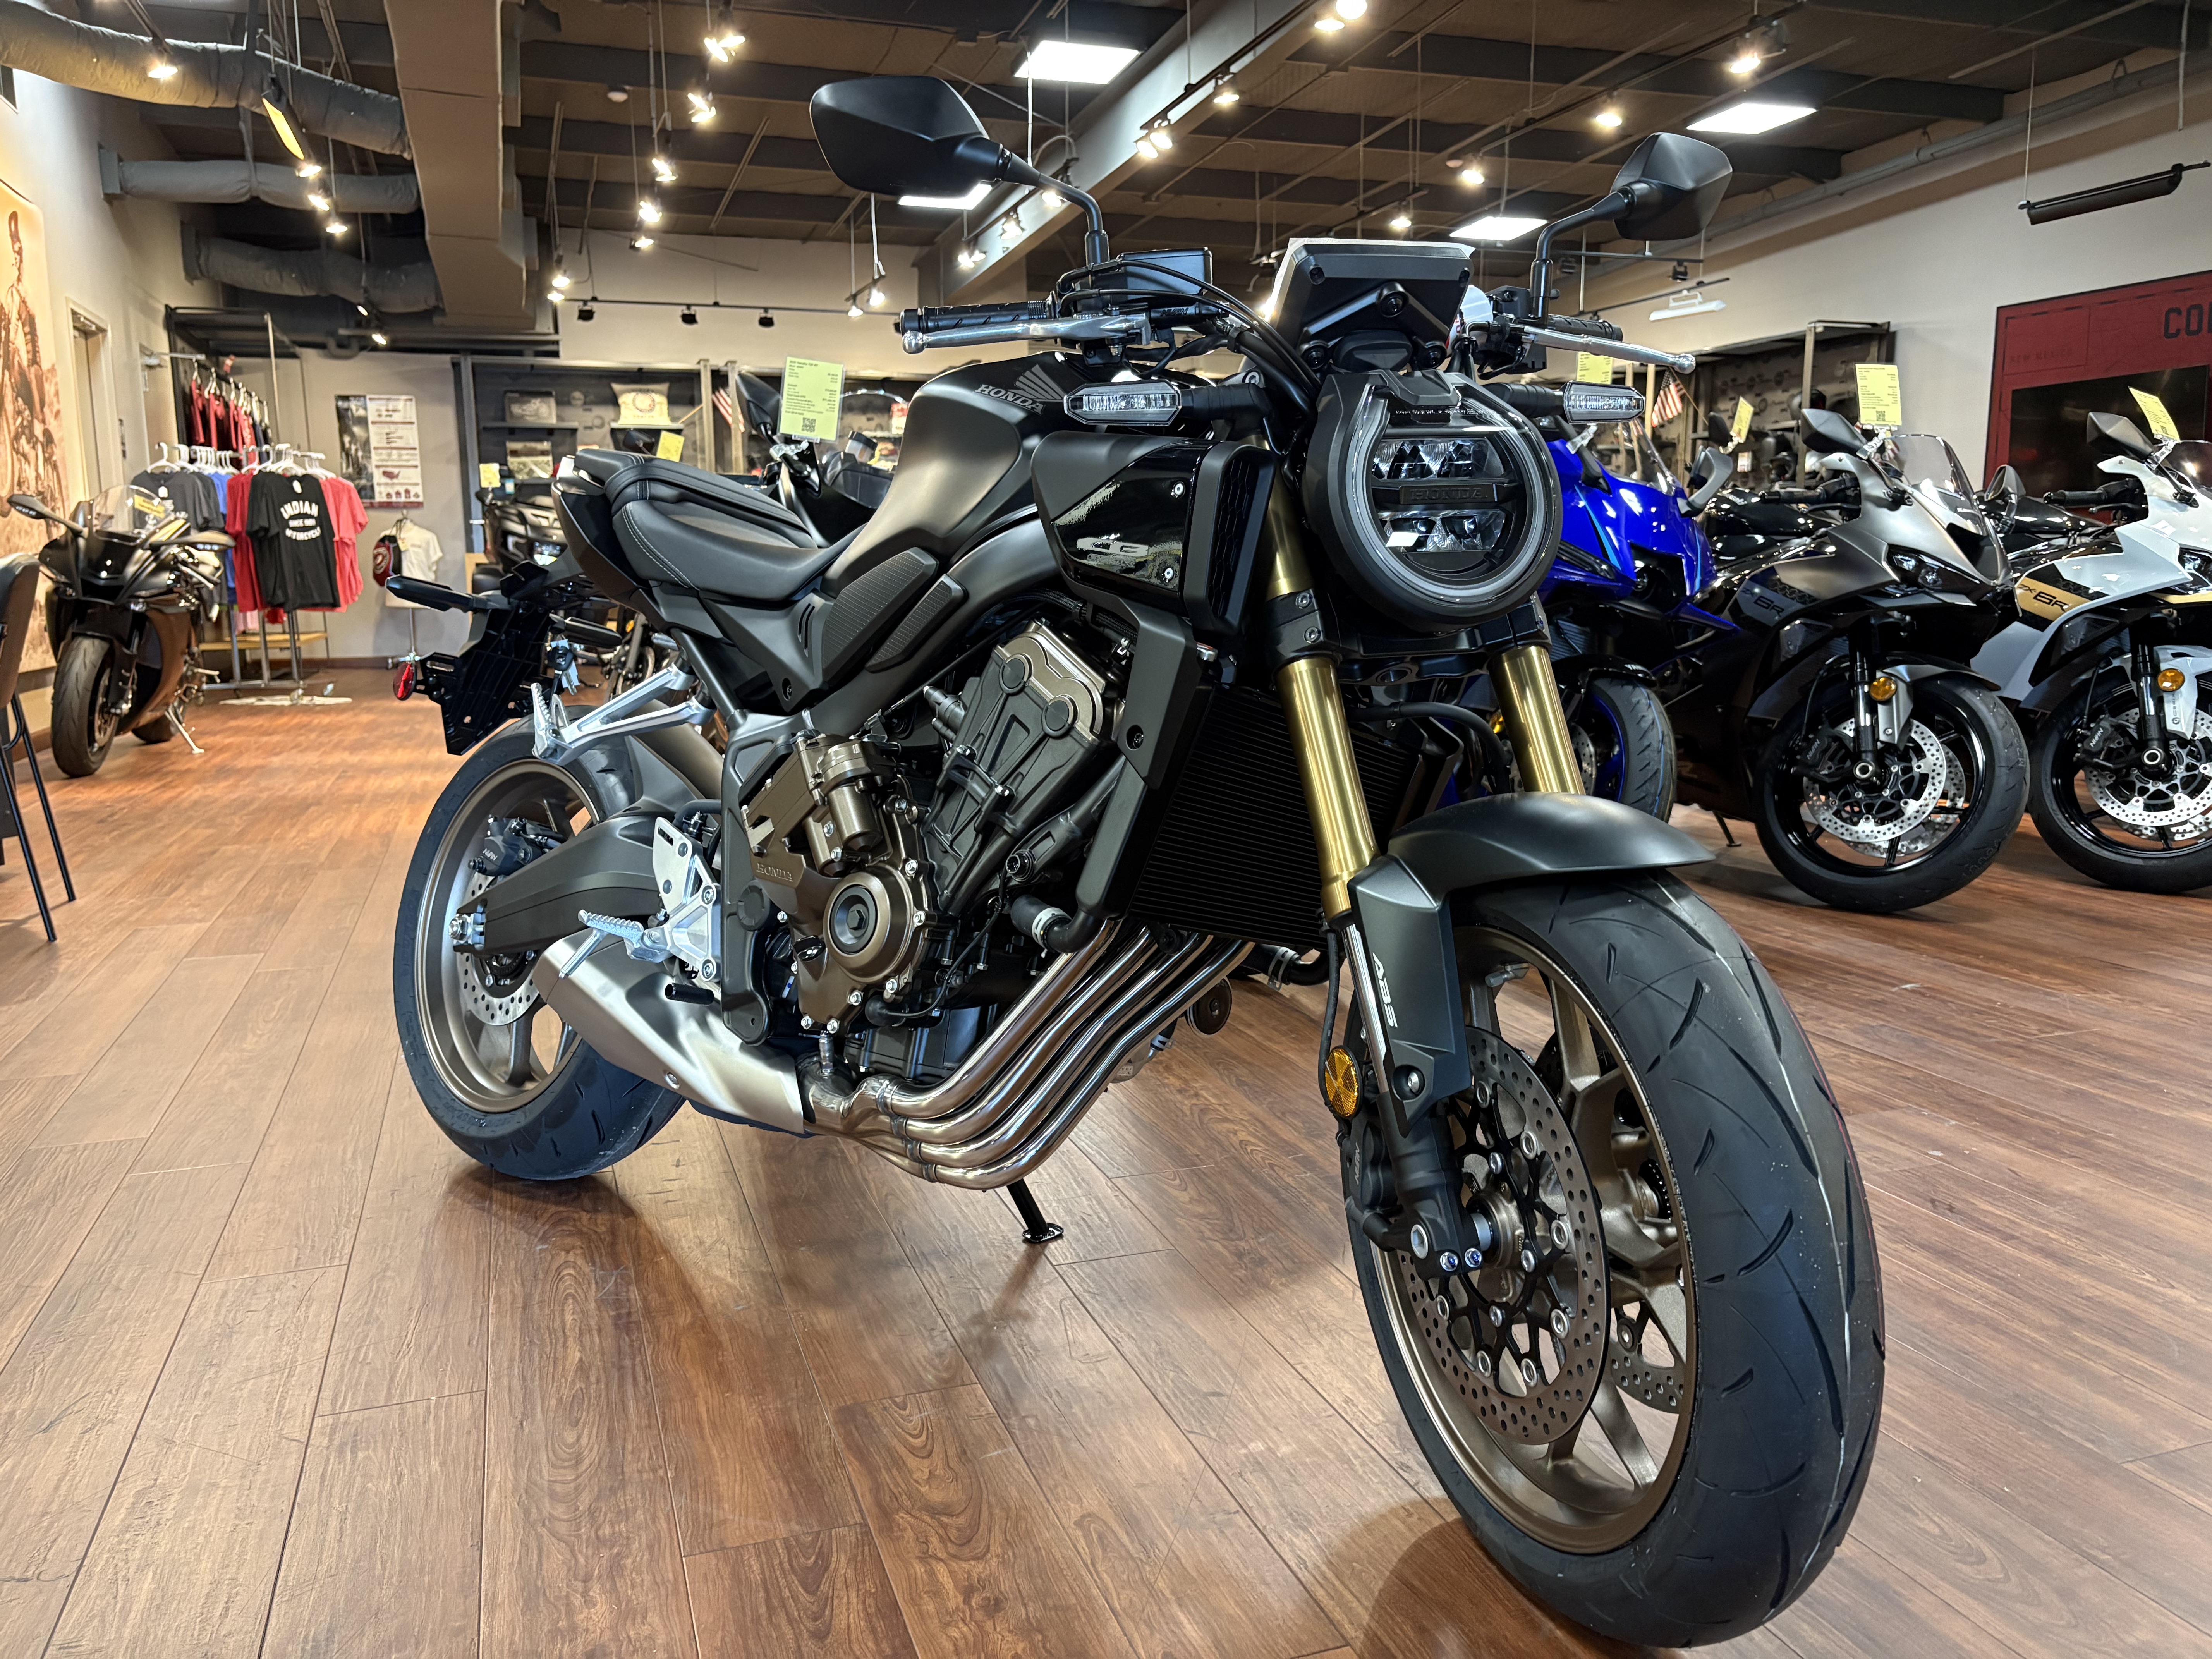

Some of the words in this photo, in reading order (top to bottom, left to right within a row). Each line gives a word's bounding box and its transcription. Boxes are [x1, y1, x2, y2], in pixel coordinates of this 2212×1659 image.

[2164, 301, 2212, 339] CO
[974, 384, 1044, 416] HONDA
[1410, 487, 1488, 501] HONDA
[280, 500, 318, 519] INDIAN
[756, 863, 794, 882] HONDA
[1372, 951, 1398, 1028] ABS
